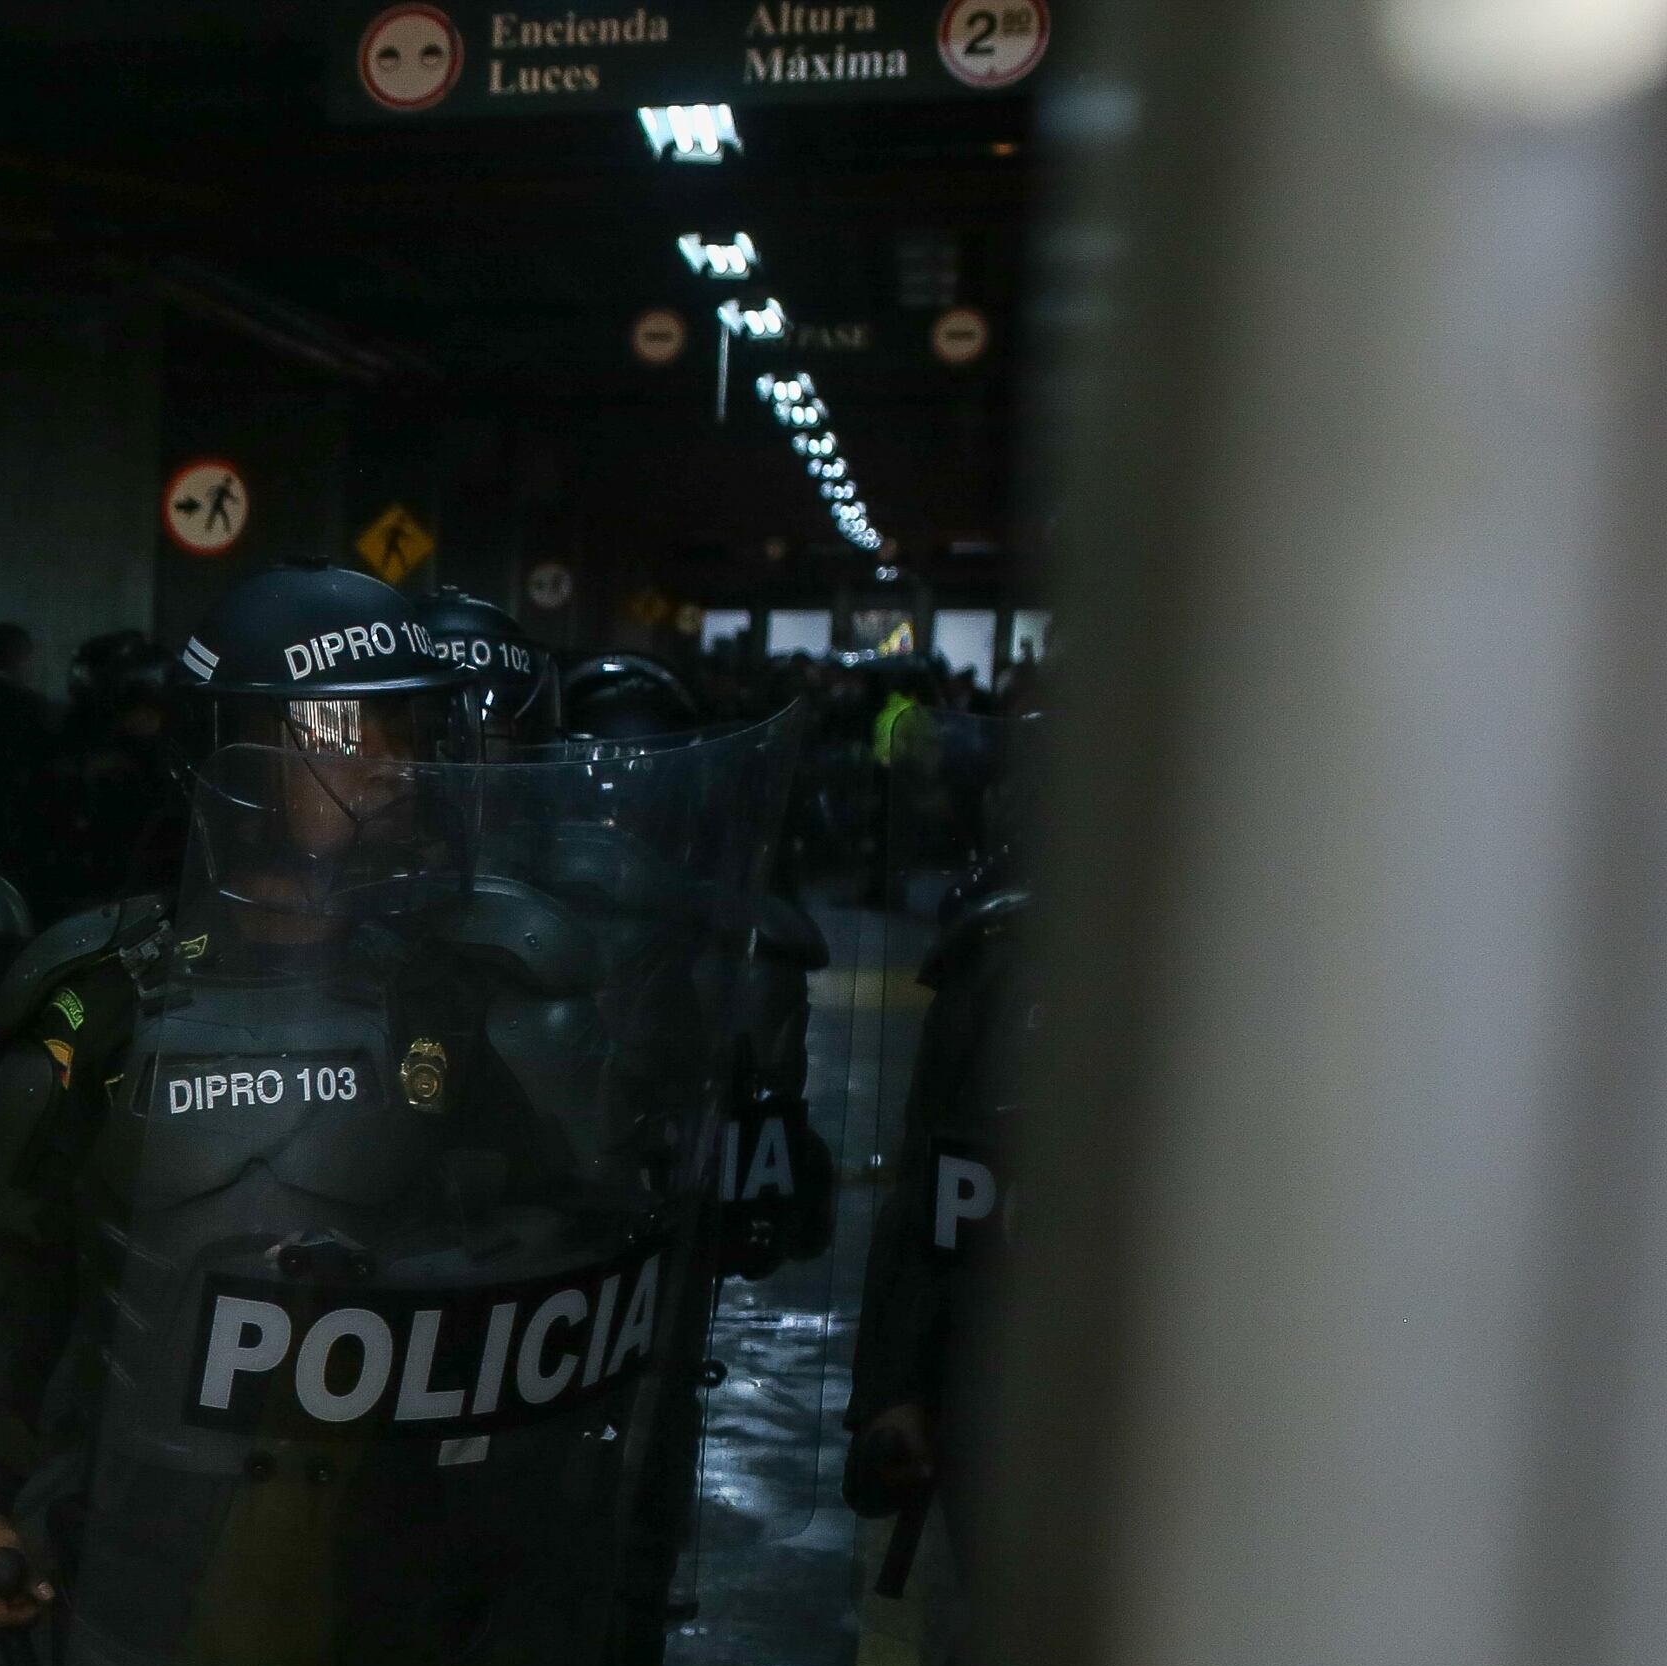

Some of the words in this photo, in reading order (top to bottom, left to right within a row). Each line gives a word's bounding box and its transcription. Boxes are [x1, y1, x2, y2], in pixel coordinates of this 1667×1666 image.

[491, 9, 668, 48] Encienda
[746, 0, 875, 36] Altura
[489, 59, 600, 95] Luces
[743, 43, 907, 83] Máxima
[284, 621, 396, 680] DIPRO
[499, 642, 530, 674] 102
[169, 1069, 284, 1114] DIPRO
[297, 1066, 357, 1101] 103
[199, 1253, 661, 1422] POLICIA
